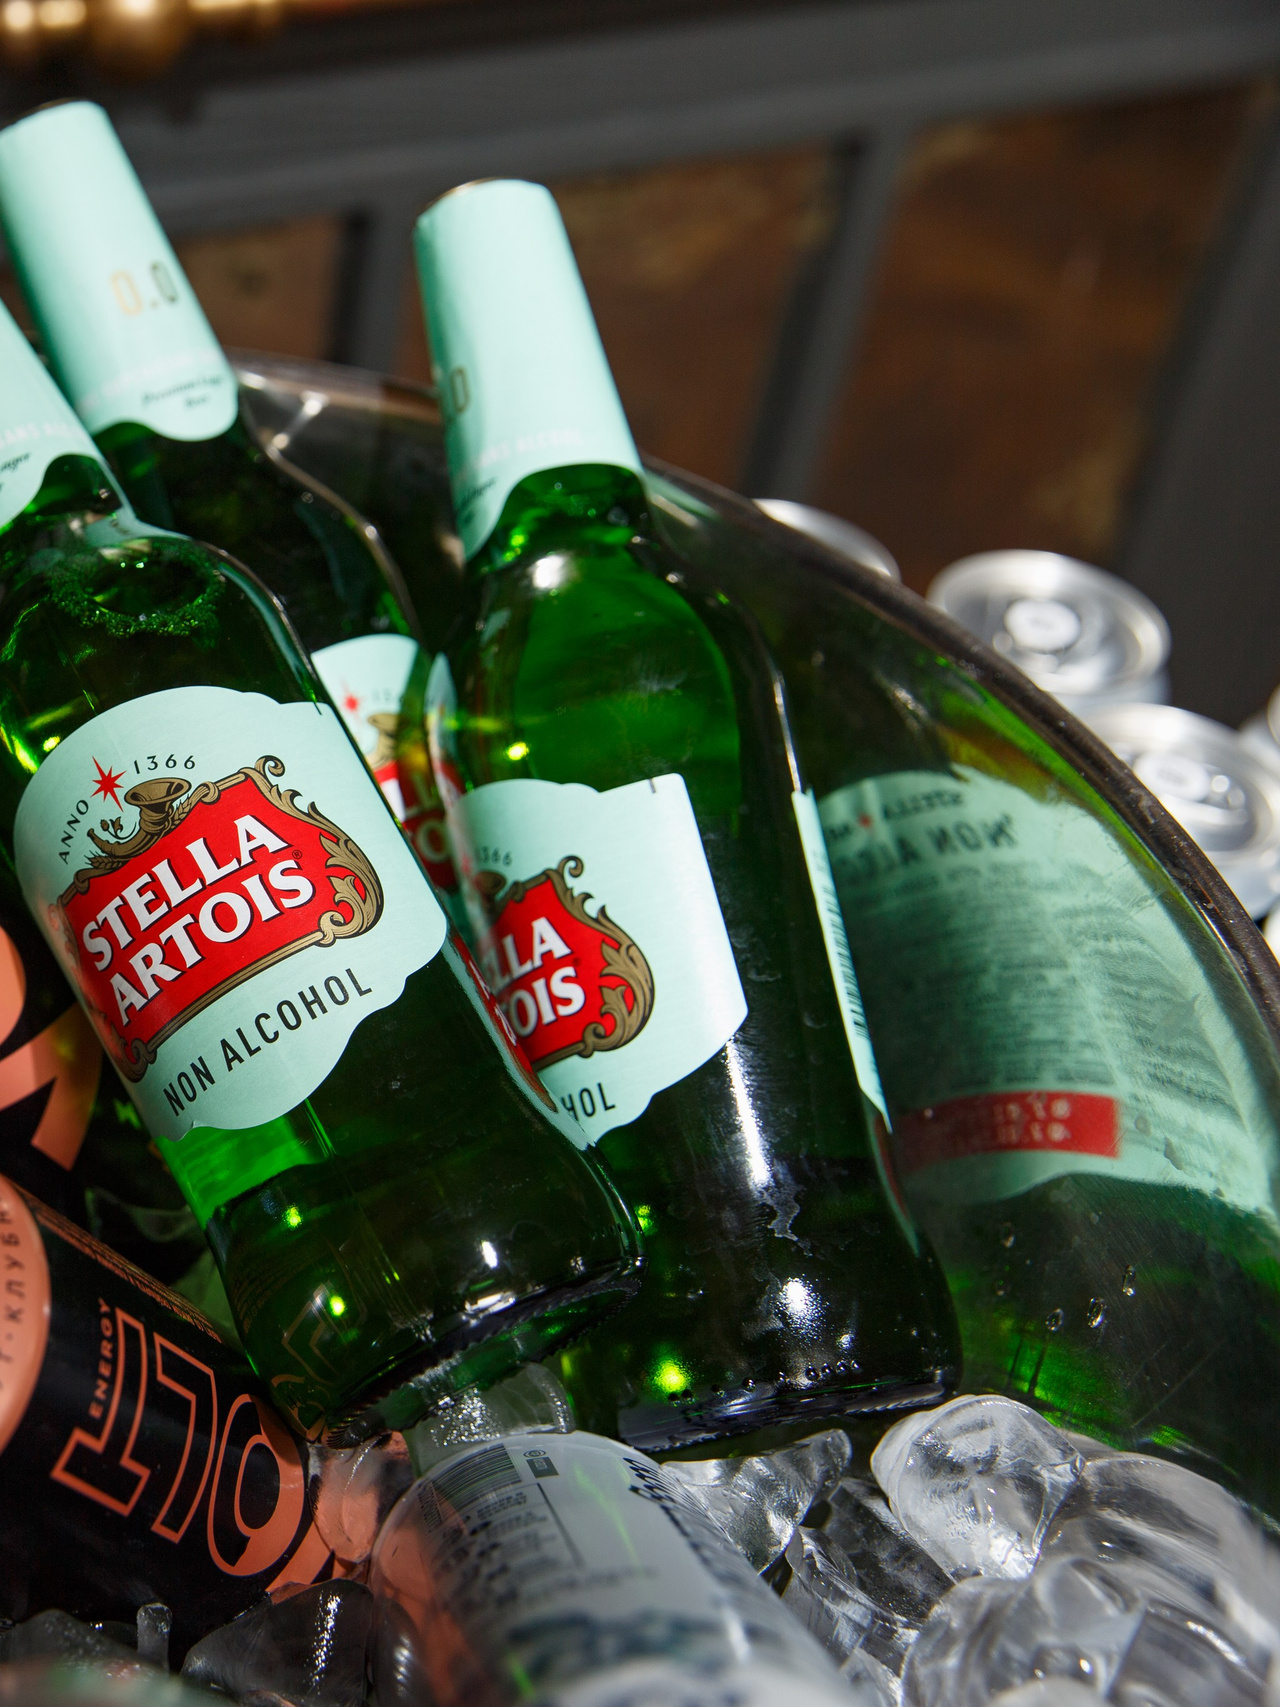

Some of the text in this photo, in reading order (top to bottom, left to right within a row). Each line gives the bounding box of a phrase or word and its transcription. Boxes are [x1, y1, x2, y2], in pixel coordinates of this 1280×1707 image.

[58, 799, 89, 865] ANNO
[133, 753, 197, 776] 1366
[82, 813, 288, 972] STELLA
[107, 866, 315, 1027] ARTOIS
[162, 1054, 216, 1117] NON
[222, 965, 373, 1072] ALCOHOL
[90, 1297, 115, 1417] ENERGY
